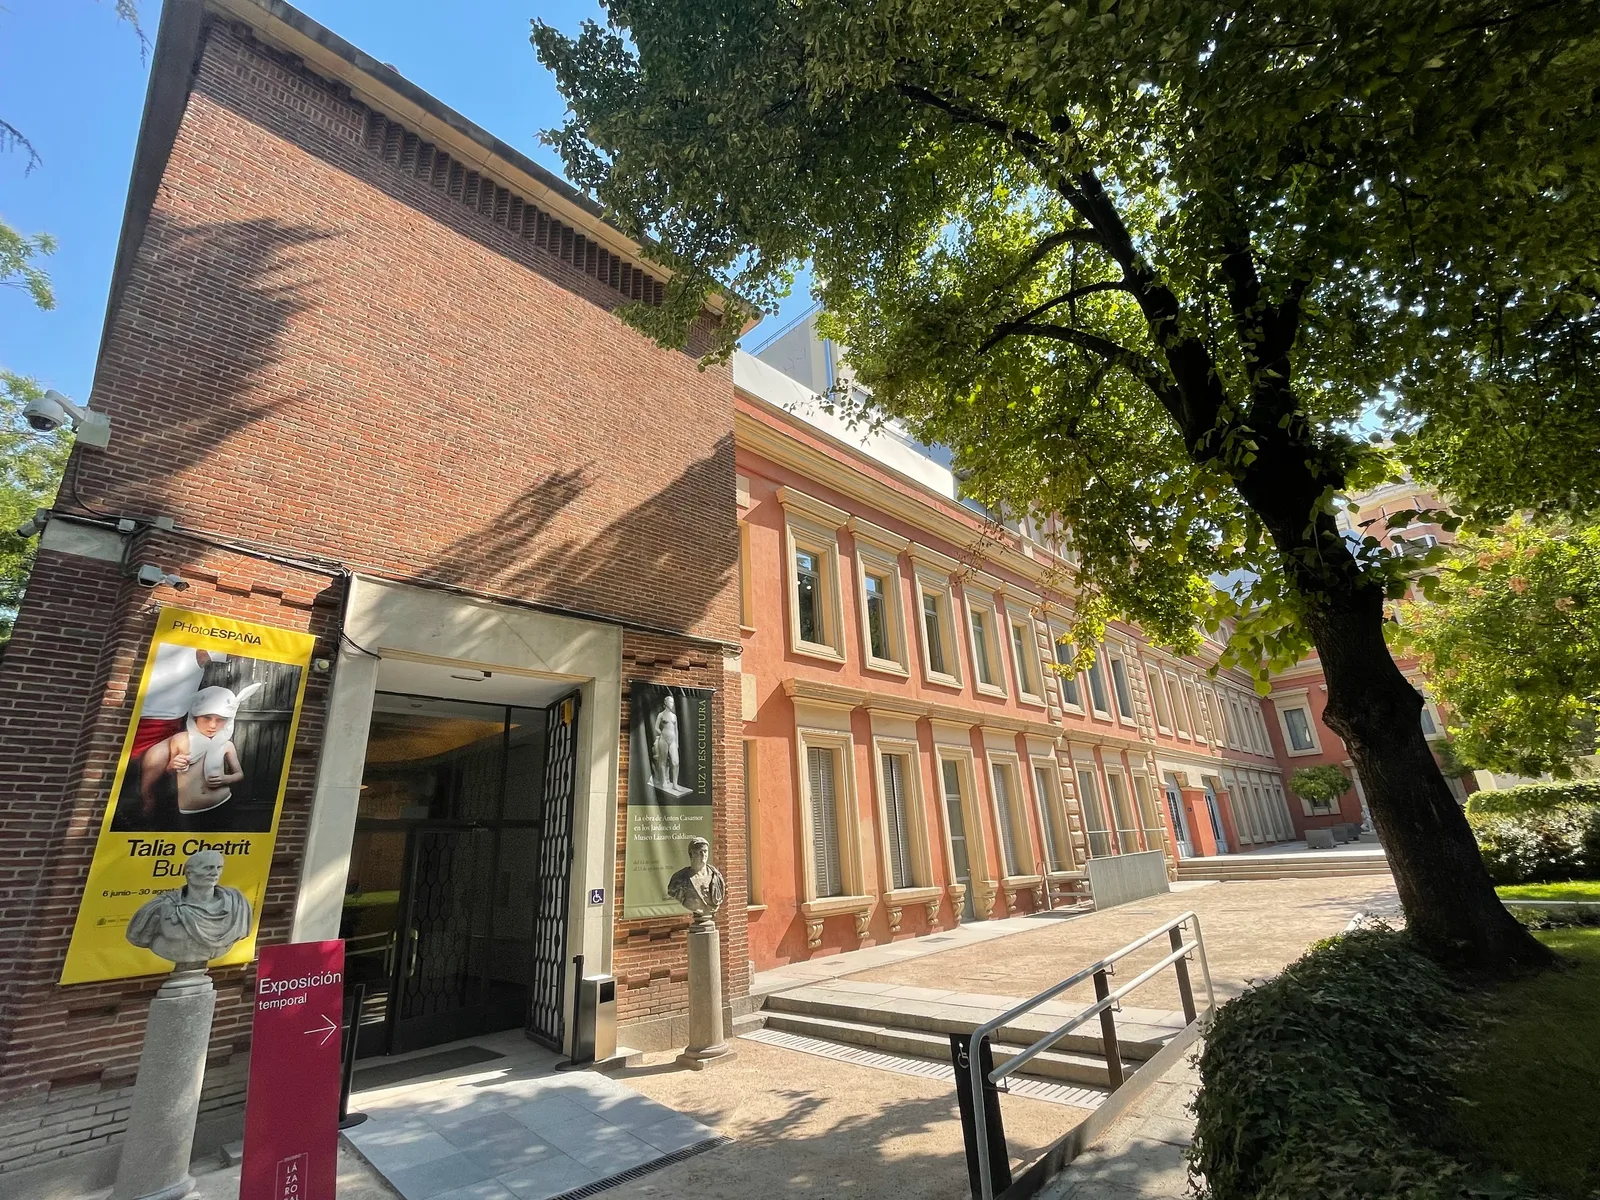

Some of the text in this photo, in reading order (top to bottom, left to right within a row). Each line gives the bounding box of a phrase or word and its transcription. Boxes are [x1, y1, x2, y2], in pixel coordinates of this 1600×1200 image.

[172, 620, 262, 645] PHotoESPAÑA
[698, 699, 706, 761] ESCULTURA
[698, 773, 706, 794] LUZ
[127, 839, 252, 857] Talia Chetrit
[258, 970, 341, 996] Exposición
[258, 992, 308, 1011] temporal
[285, 1184, 298, 1195] RO
[286, 1174, 298, 1185] ZA
